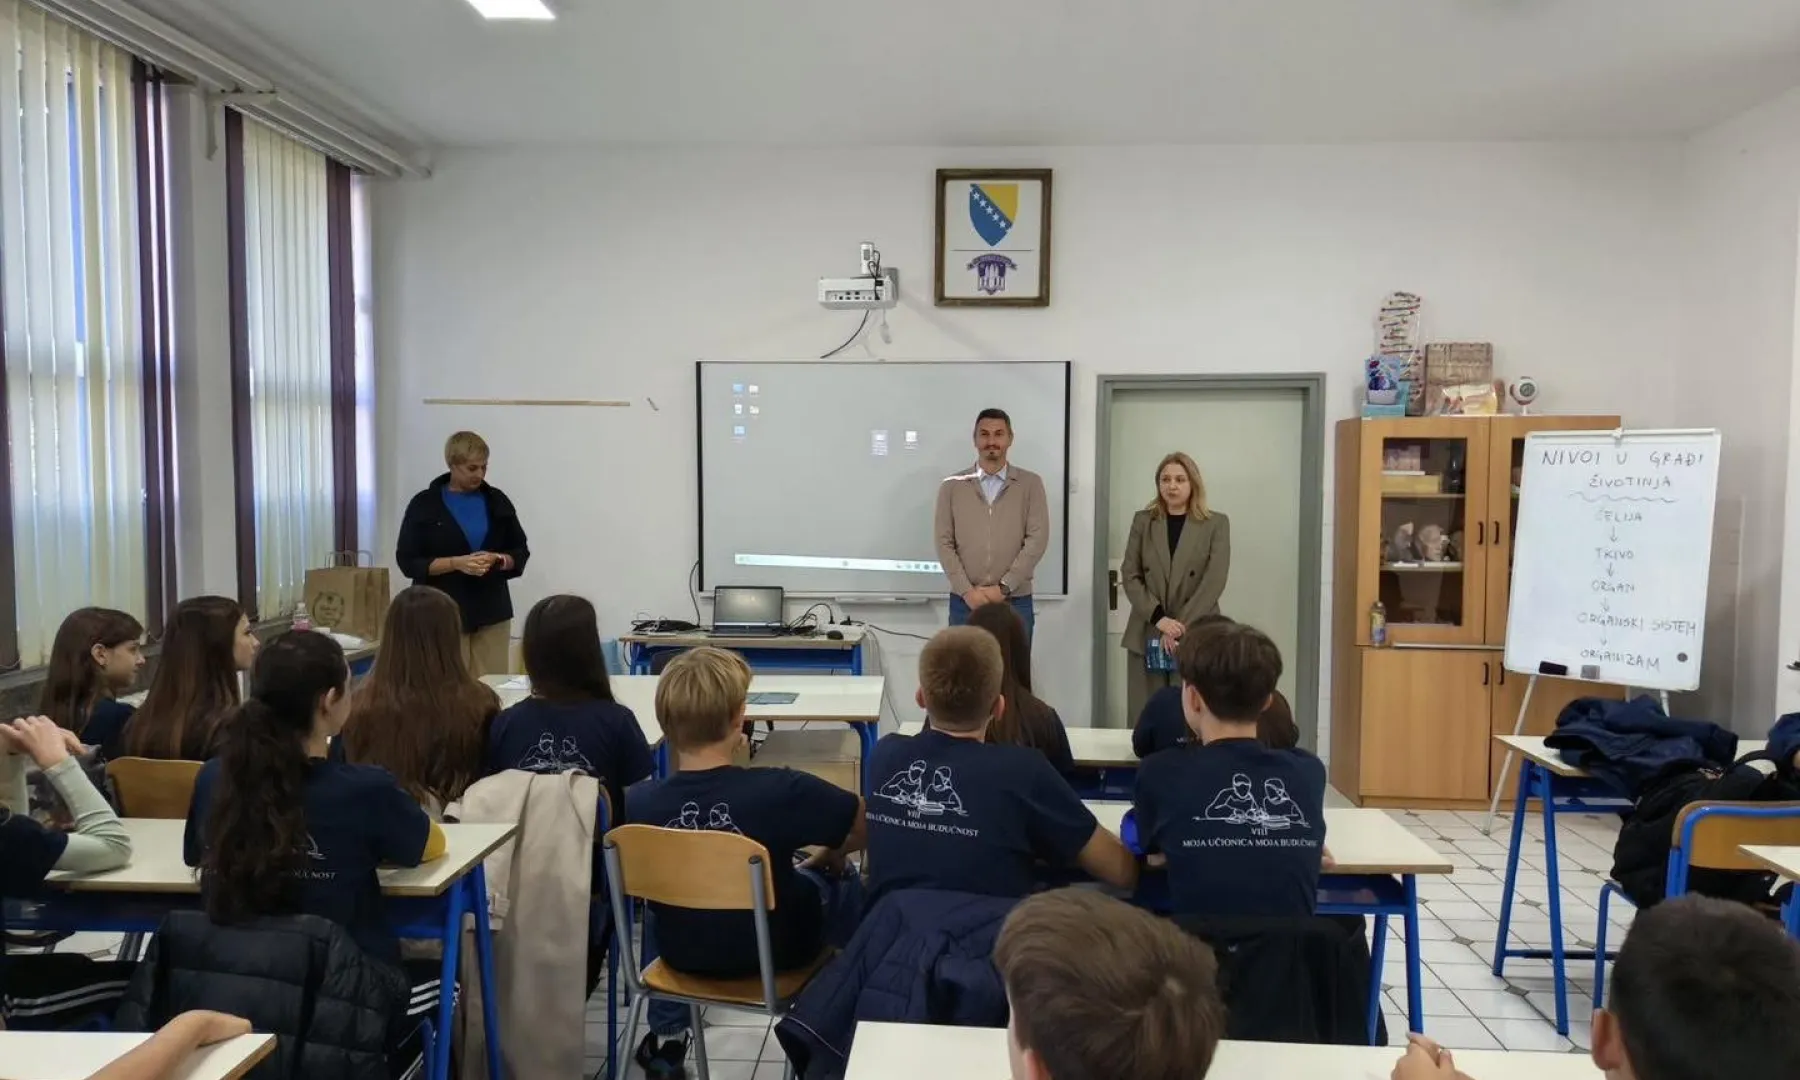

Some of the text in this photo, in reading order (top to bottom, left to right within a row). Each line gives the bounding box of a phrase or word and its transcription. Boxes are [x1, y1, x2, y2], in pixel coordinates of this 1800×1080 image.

[1541, 450, 1601, 466] NIVOI
[1616, 452, 1628, 465] U
[1595, 547, 1634, 560] TKIVO
[1592, 579, 1635, 593] ORGAN
[1577, 611, 1697, 636] ORGANSKI SISTEM
[1580, 648, 1661, 672] ORGANIZAM
[1183, 838, 1207, 847] MOJA
[1254, 839, 1280, 847] MOJA
